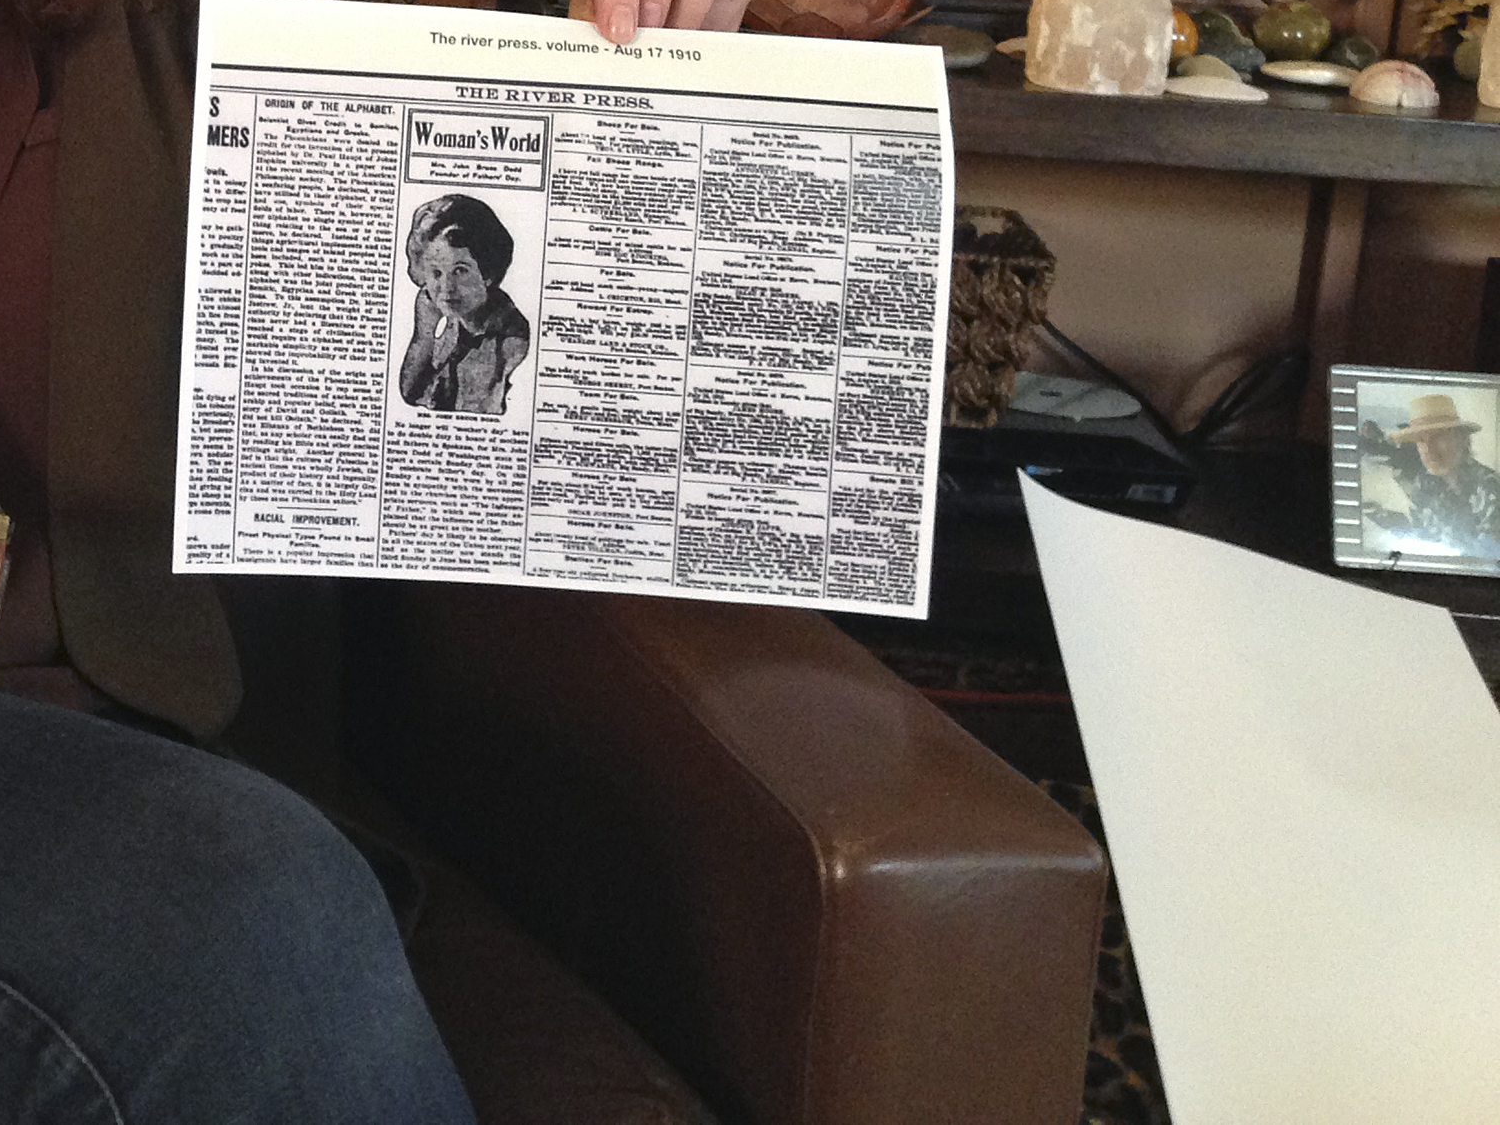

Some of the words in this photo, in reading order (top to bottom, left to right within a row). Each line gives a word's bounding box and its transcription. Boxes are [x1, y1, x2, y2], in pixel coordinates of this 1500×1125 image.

[430, 32, 455, 44] The
[461, 34, 492, 46] river
[498, 38, 541, 51] press.
[546, 39, 598, 53] volume
[614, 44, 643, 58] Aug
[647, 47, 662, 57] 17
[668, 49, 700, 60] 1910
[264, 98, 294, 108] ORIGIN
[302, 100, 313, 110] OF
[320, 101, 338, 111] THE
[345, 103, 394, 114] ALPHABET.
[455, 86, 498, 99] THE
[505, 87, 575, 105] RIVER
[583, 93, 653, 109] PRESS.
[207, 124, 249, 148] MERS
[413, 121, 489, 150] Woman's
[489, 126, 540, 152] World
[505, 174, 520, 182] Day.
[254, 513, 284, 523] RACIAL
[292, 515, 359, 526] IMPROVEMENT.
